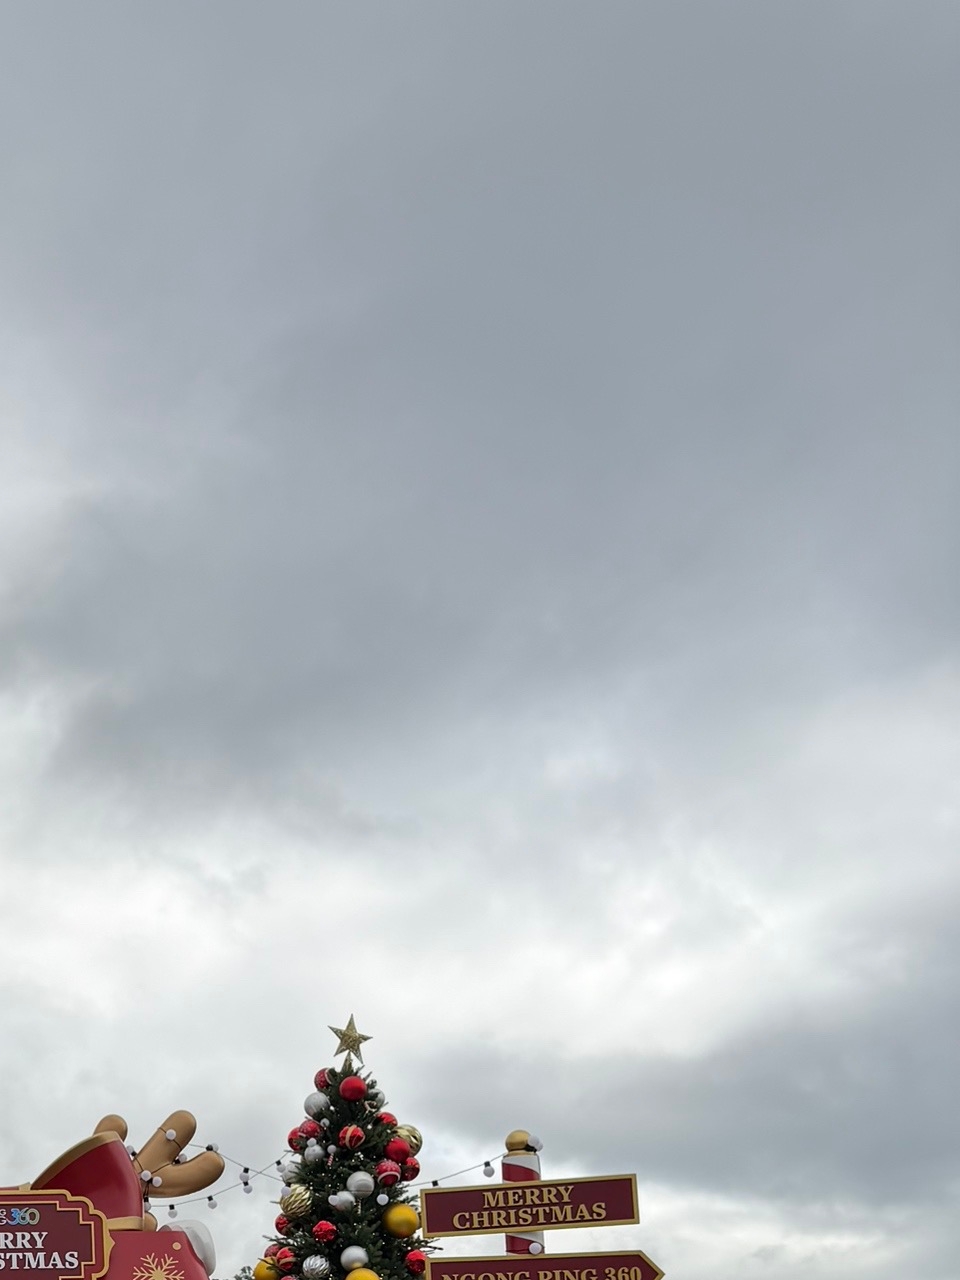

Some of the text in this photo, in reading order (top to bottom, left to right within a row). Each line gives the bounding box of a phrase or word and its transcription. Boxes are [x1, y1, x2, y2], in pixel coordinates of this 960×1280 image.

[482, 1185, 575, 1209] MERRY
[7, 1207, 40, 1226] 360
[452, 1202, 607, 1230] CHRISTMAS
